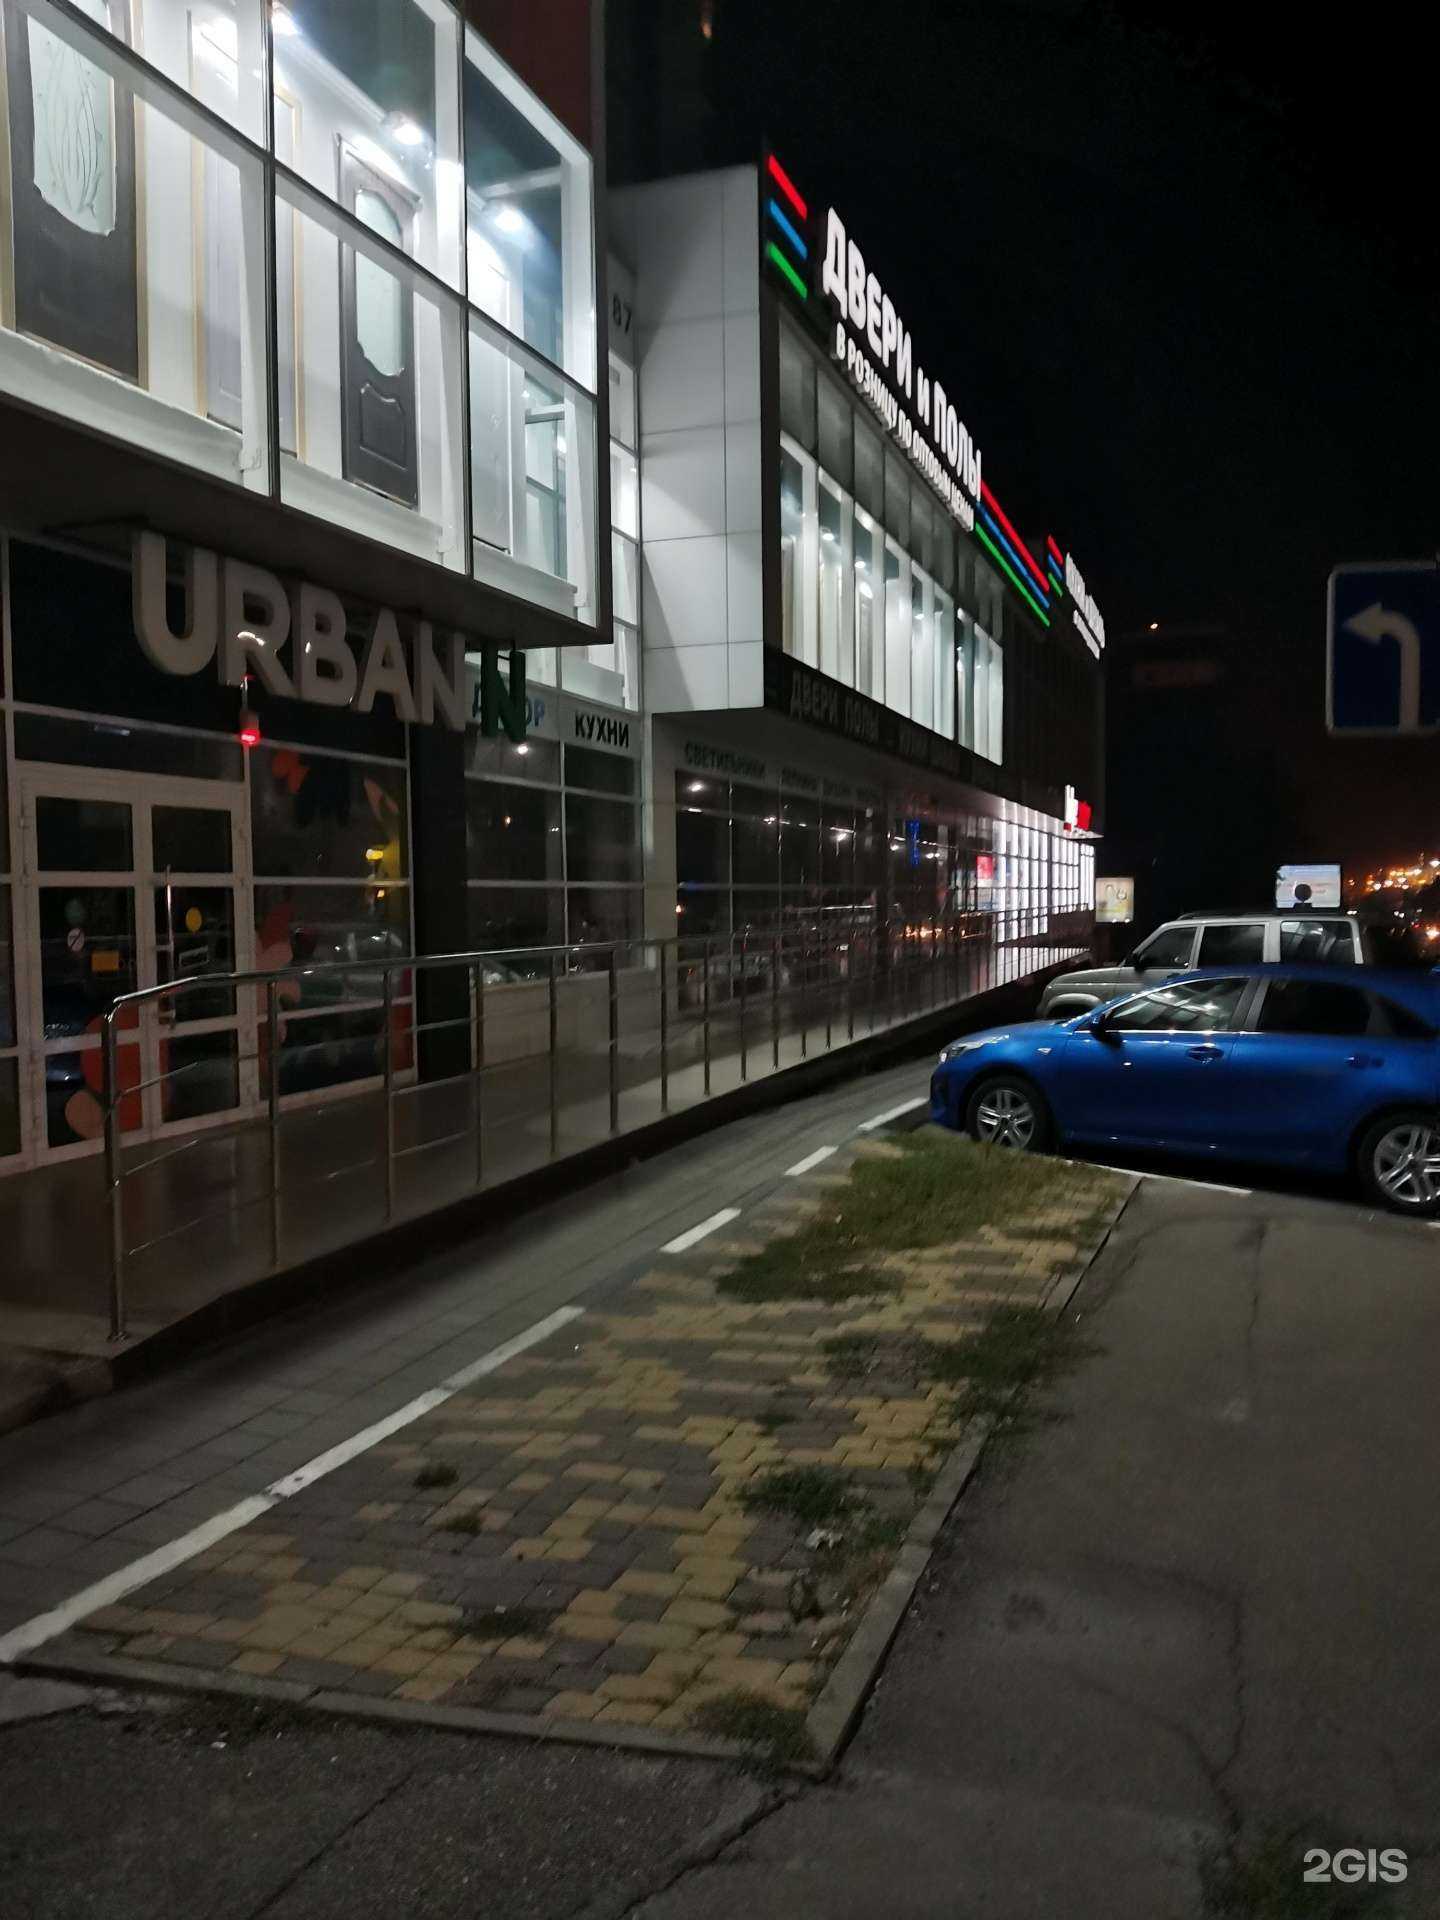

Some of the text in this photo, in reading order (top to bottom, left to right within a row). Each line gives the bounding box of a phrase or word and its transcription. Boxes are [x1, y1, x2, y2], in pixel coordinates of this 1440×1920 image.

[823, 207, 912, 399] ДВЕРИ
[934, 381, 982, 502] ПОЛЫ
[132, 529, 476, 733] URBAN
[575, 710, 630, 749] КУХНИ
